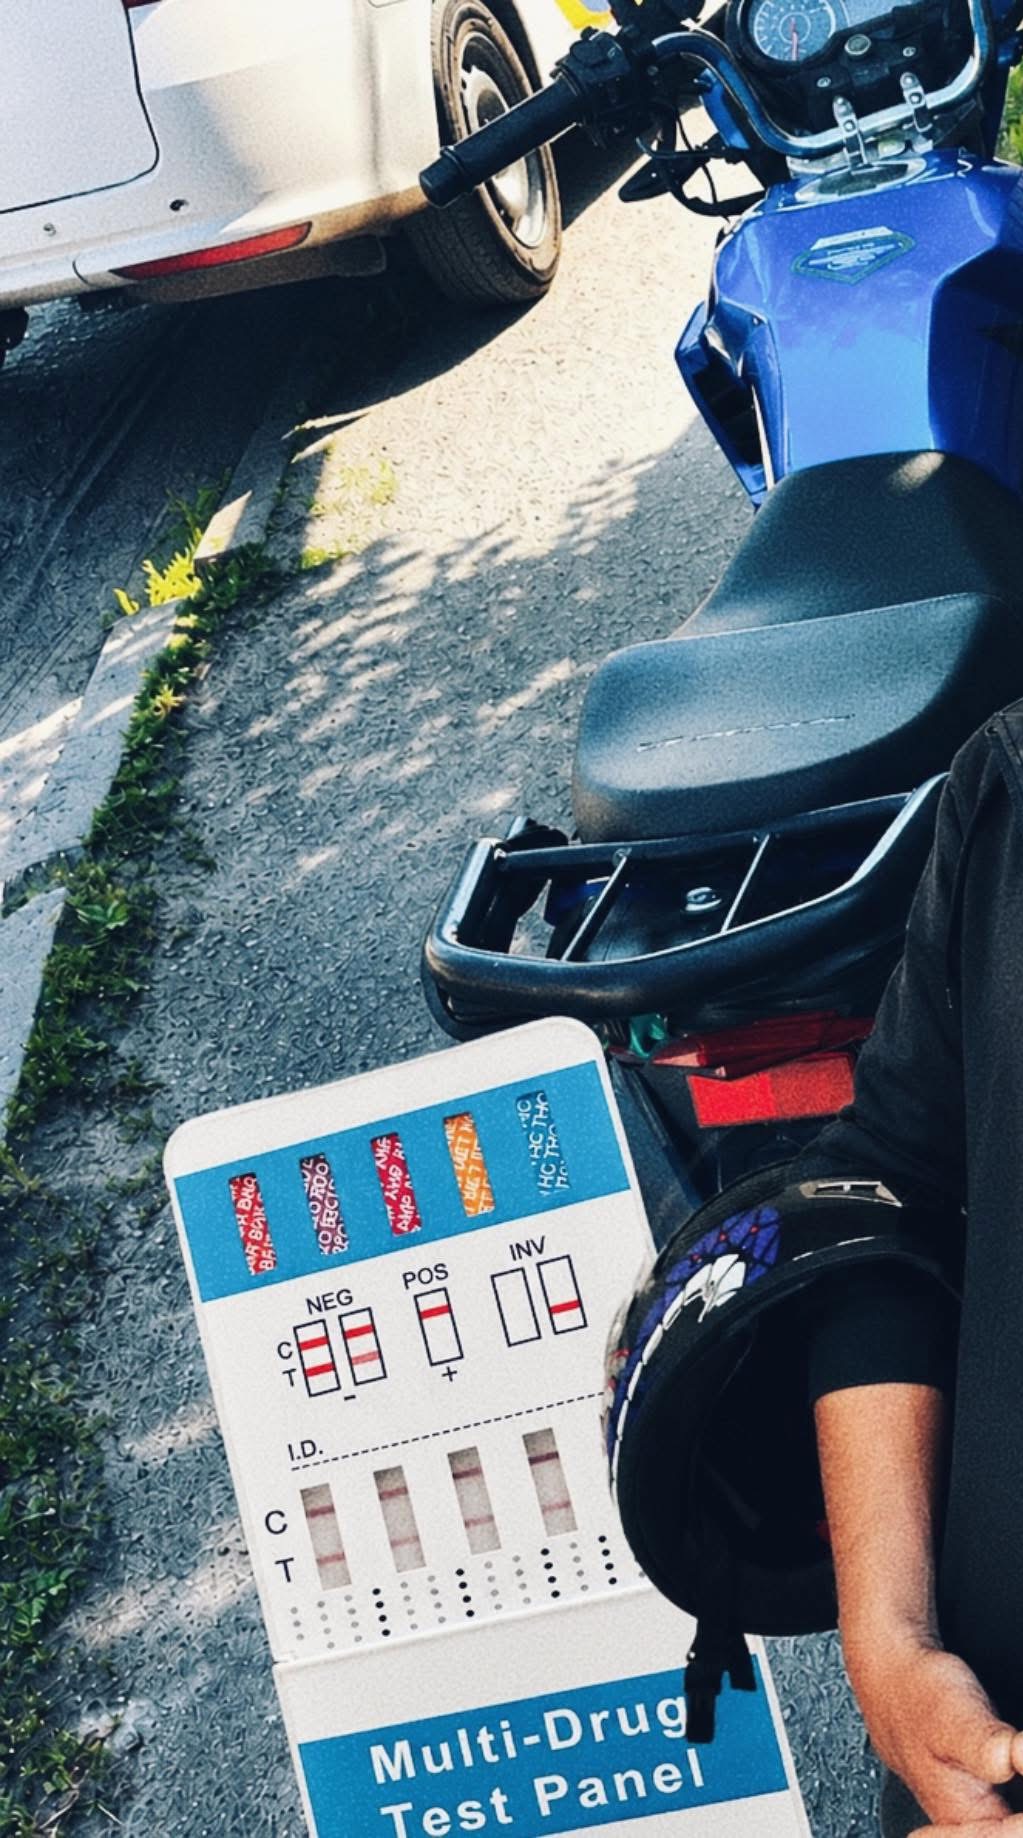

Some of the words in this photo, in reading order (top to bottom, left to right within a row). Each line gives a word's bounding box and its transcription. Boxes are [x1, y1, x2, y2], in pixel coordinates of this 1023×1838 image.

[509, 1236, 547, 1261] INV
[402, 1263, 449, 1290] POS
[306, 1289, 354, 1315] NEG
[277, 1342, 293, 1359] C
[282, 1368, 296, 1387] T
[288, 1439, 323, 1461] I.D.
[265, 1510, 288, 1535] C
[275, 1557, 295, 1582] T
[369, 1696, 688, 1785] Multi-Drug
[380, 1787, 514, 1838] Test
[533, 1748, 705, 1817] Panel
